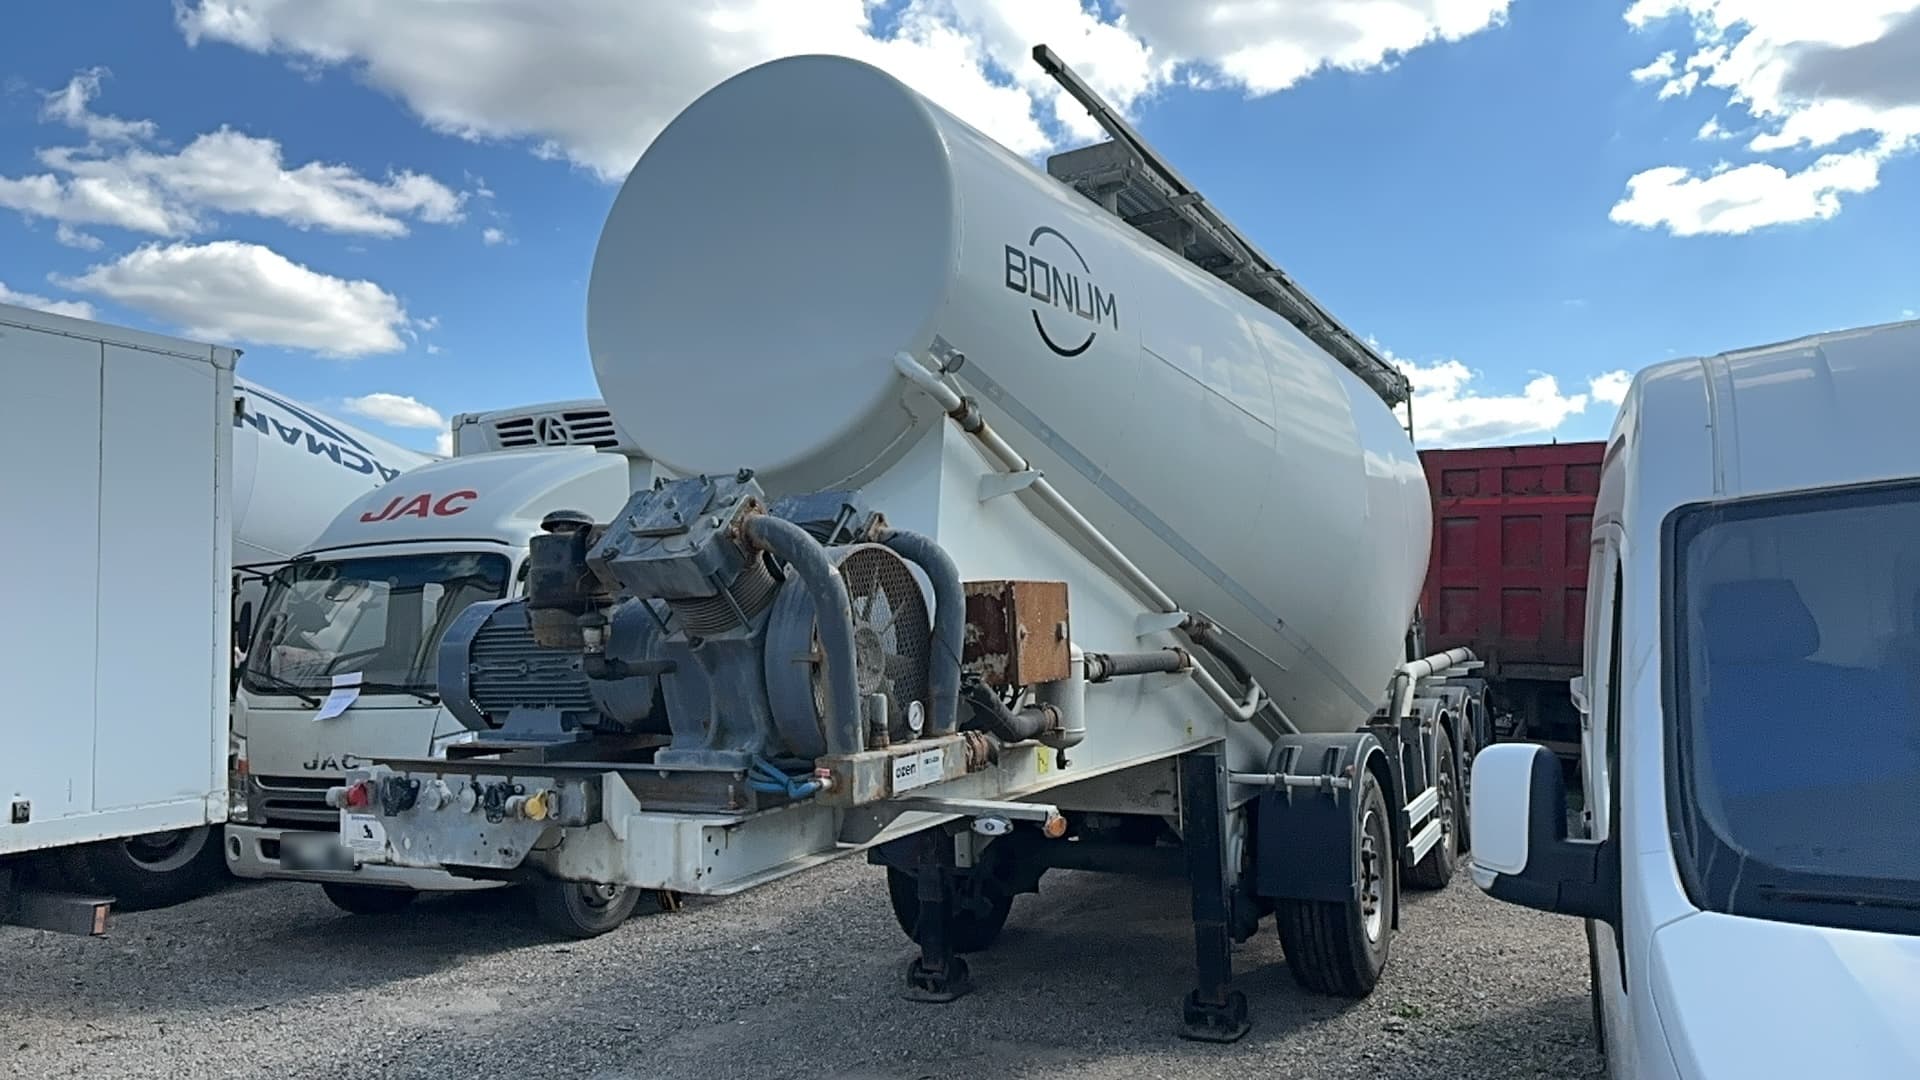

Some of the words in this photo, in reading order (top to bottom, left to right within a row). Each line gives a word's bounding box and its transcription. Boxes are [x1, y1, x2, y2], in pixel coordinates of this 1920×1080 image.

[1005, 244, 1118, 331] BONUM
[360, 490, 477, 522] JAC
[303, 753, 360, 771] JAC
